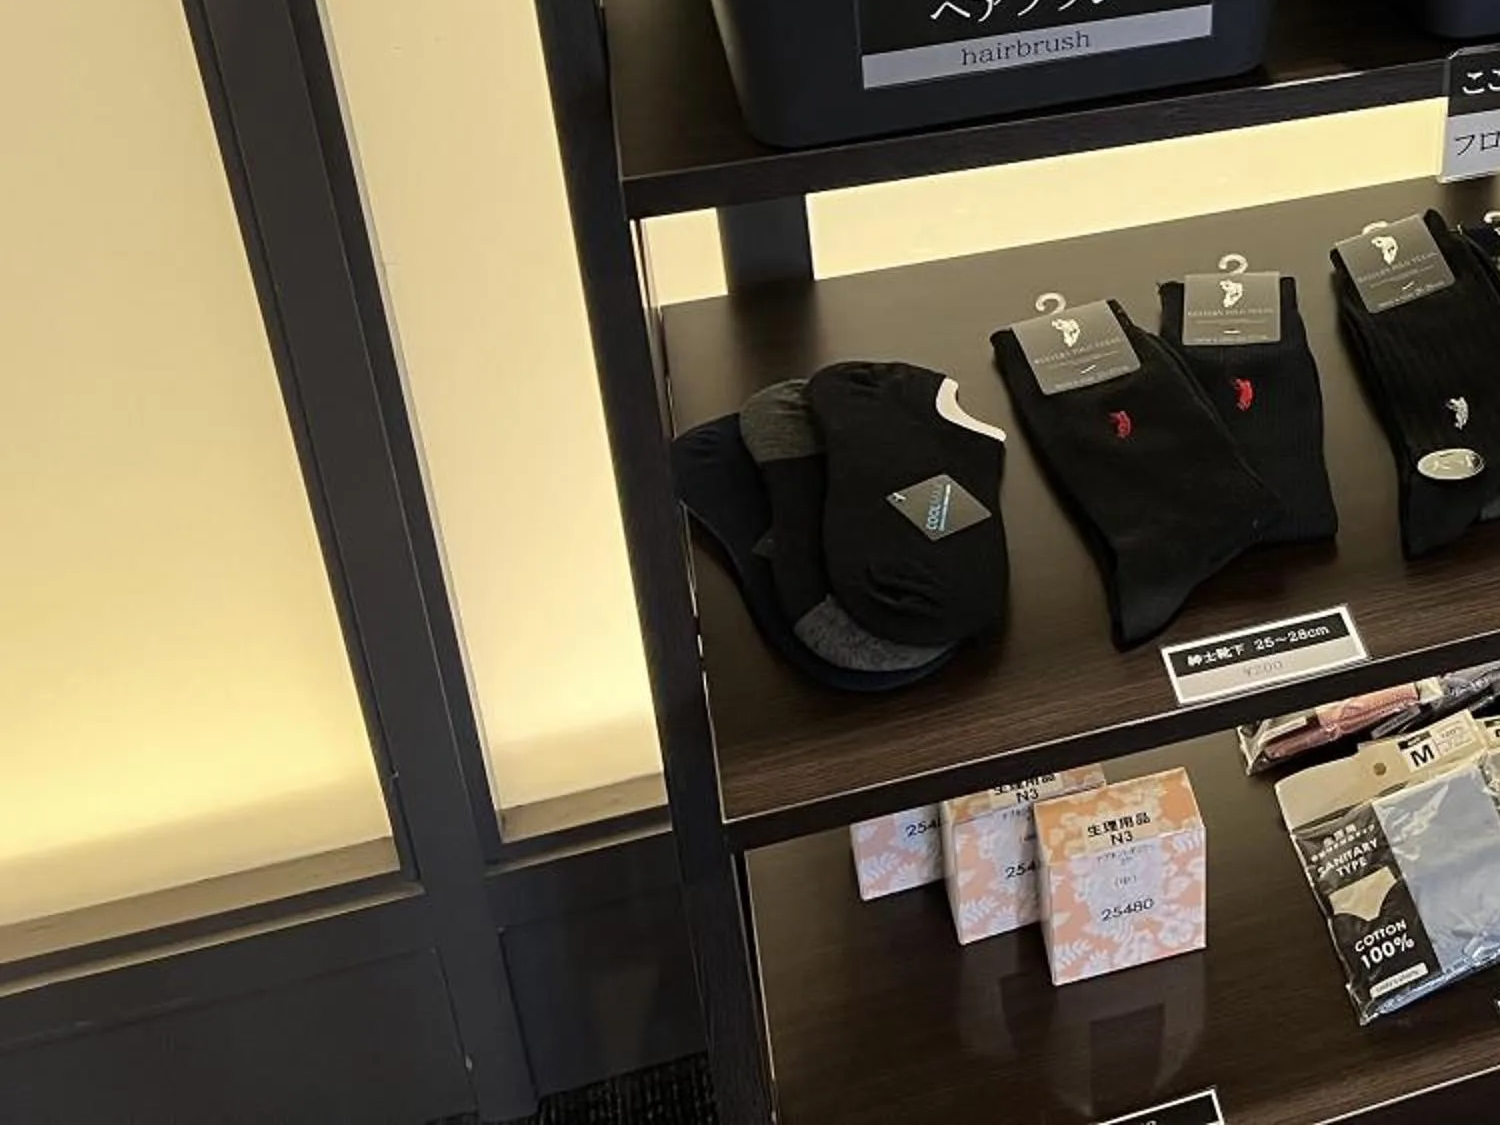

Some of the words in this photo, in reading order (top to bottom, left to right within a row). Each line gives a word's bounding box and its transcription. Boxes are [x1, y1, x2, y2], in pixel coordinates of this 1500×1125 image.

[961, 30, 1092, 66] hairbrush
[1186, 642, 1246, 666] 紳士靴下
[1409, 745, 1436, 768] M
[1016, 789, 1039, 804] N3
[1087, 811, 1151, 838] 生理用品
[1110, 830, 1133, 845] N3
[1317, 837, 1377, 878] SANITARY
[1336, 856, 1367, 877] TYPE
[1101, 898, 1154, 921] 25480
[1354, 920, 1407, 953] COTTON
[1359, 933, 1415, 970] 100%
